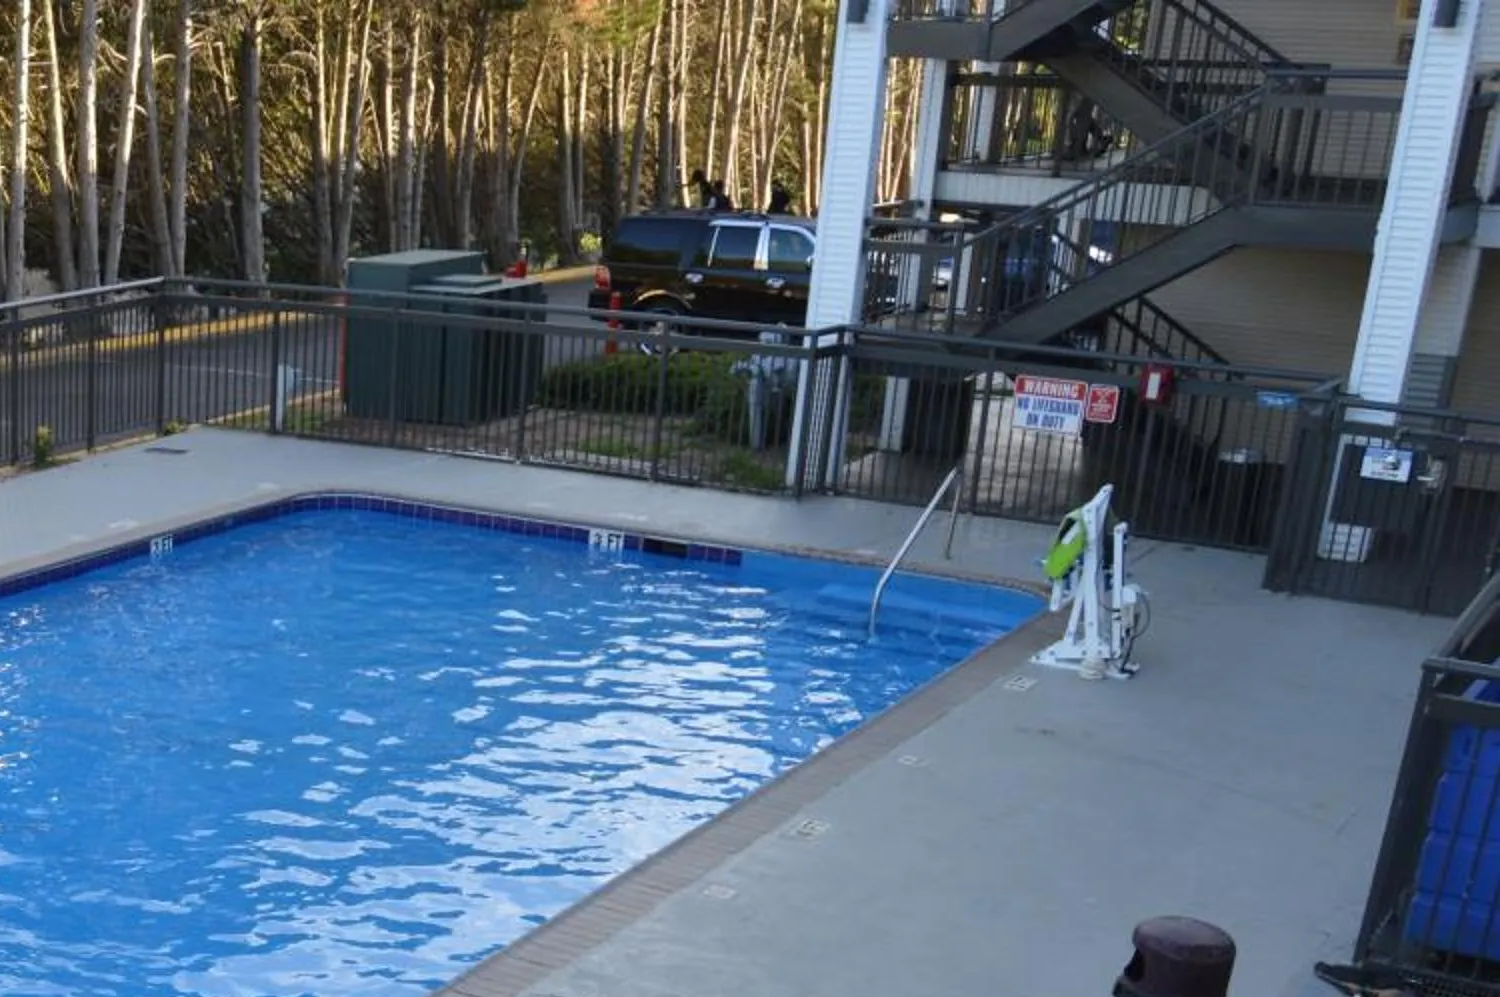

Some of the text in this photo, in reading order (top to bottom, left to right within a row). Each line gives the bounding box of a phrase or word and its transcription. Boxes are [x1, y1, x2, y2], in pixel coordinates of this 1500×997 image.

[1025, 380, 1079, 399] WARNING
[1017, 397, 1030, 410] NO
[1032, 399, 1080, 416] LIFEGUARD
[1026, 412, 1066, 429] ON DUTY
